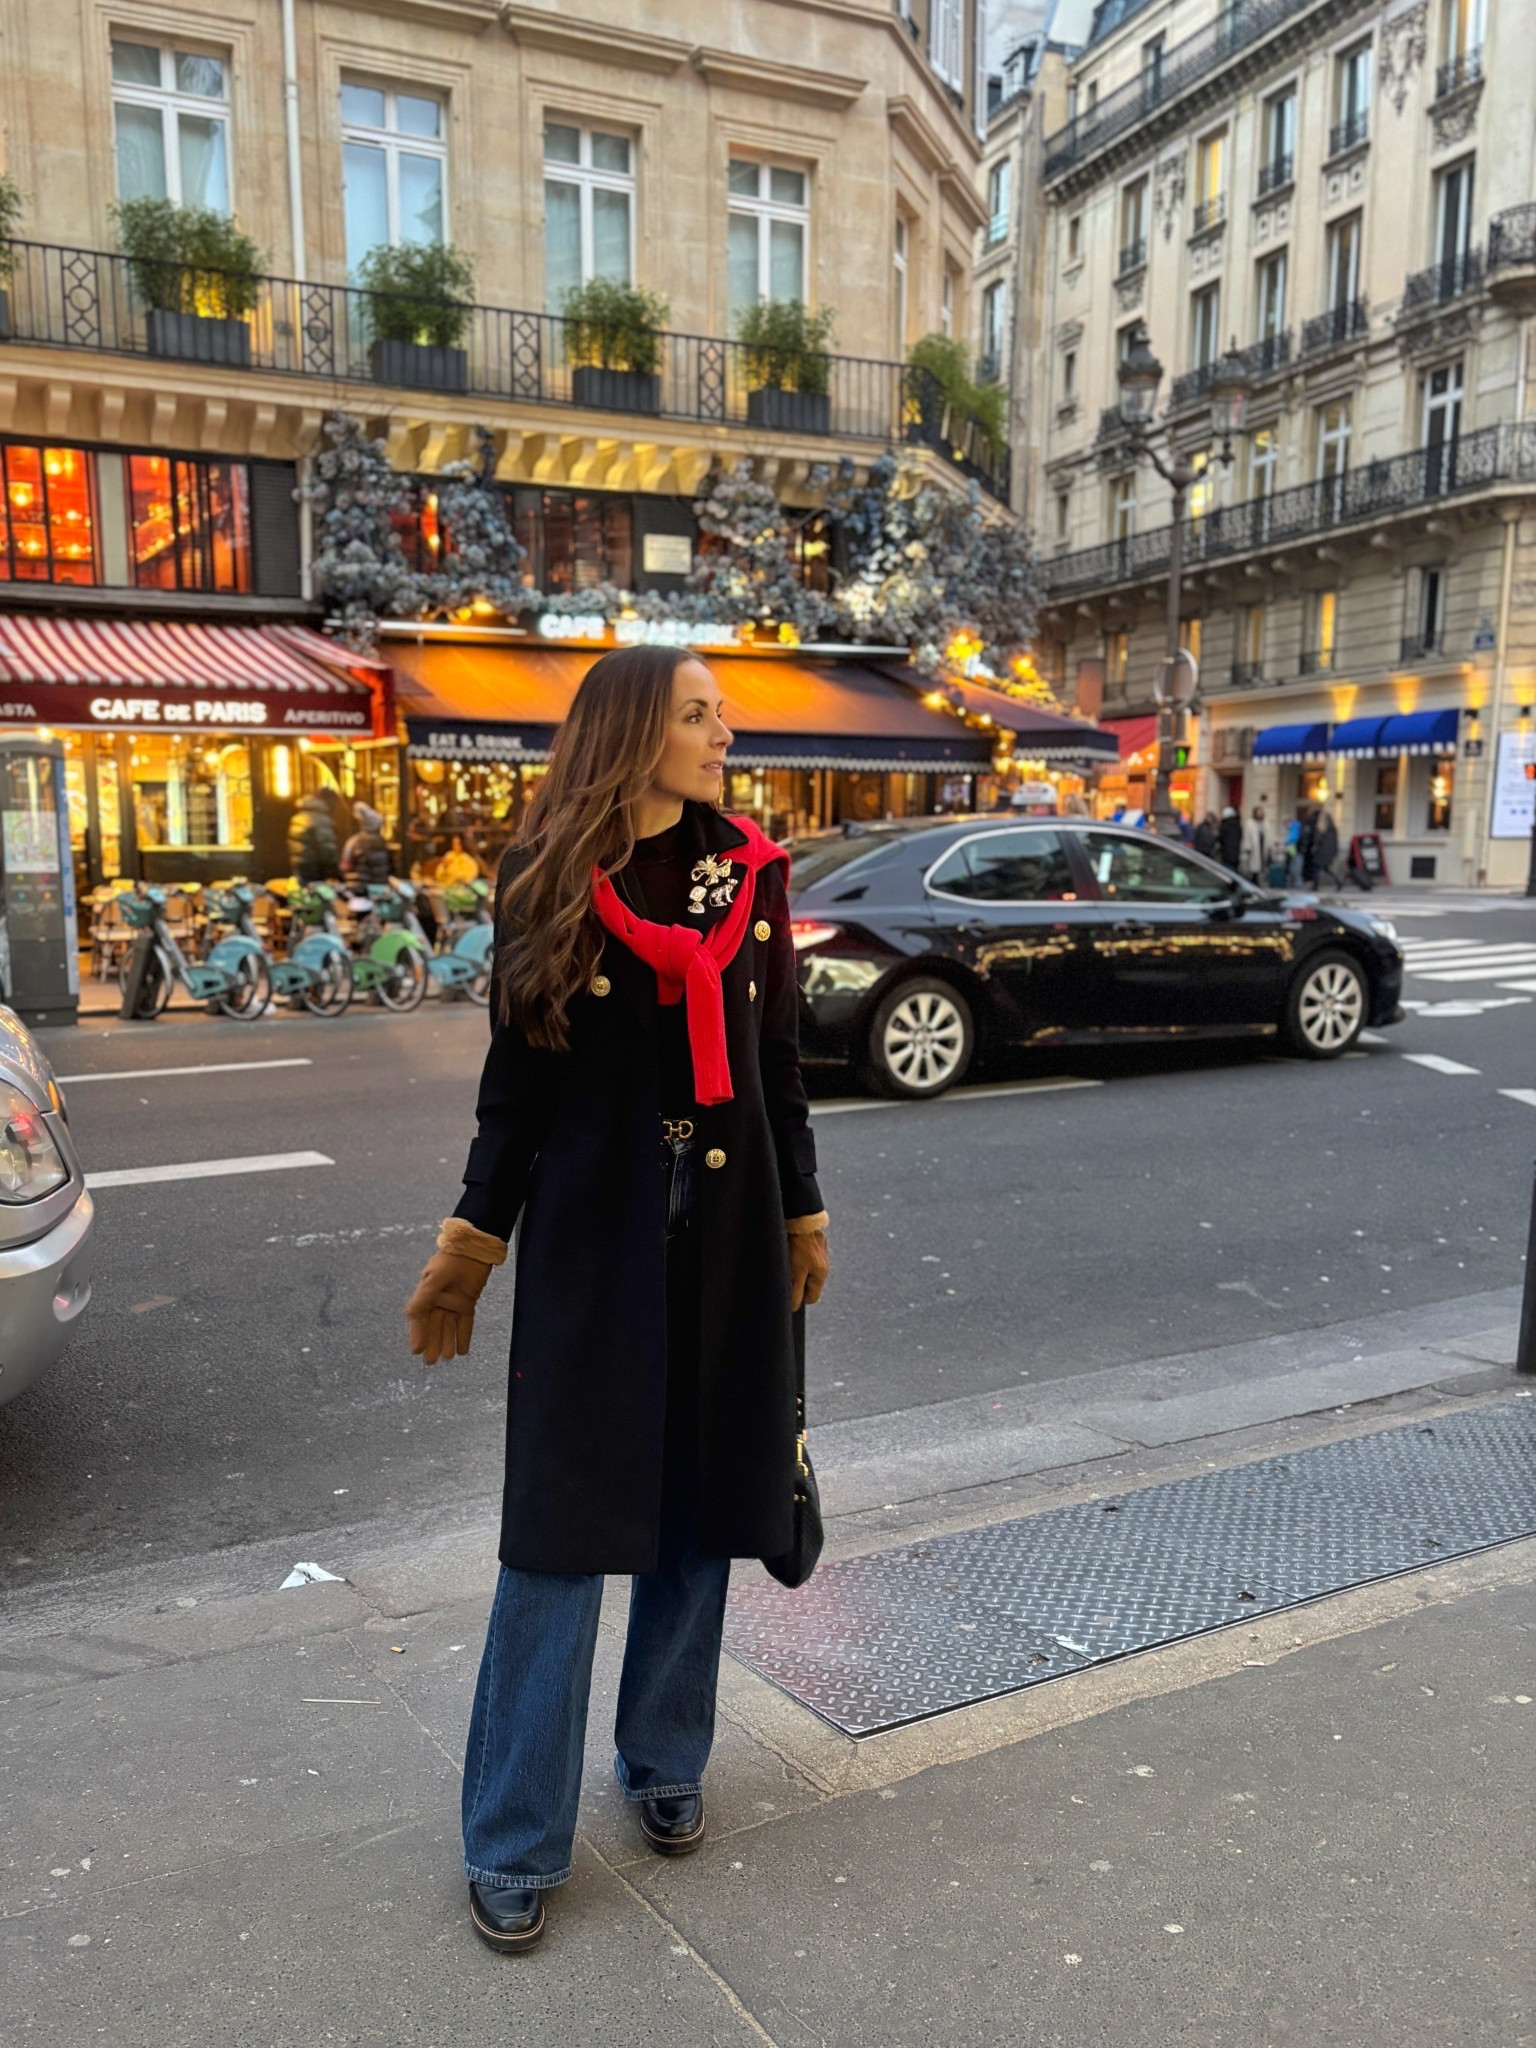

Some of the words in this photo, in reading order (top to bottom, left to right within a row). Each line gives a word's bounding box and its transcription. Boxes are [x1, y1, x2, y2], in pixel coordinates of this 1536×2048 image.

[539, 613, 605, 640] CAFE
[90, 697, 161, 720] CAFE
[163, 703, 192, 722] DE
[194, 701, 268, 724] PARIS
[283, 707, 366, 726] APERITIVO
[428, 732, 457, 748] EAT
[460, 733, 474, 748] &
[475, 734, 522, 750] DRINK
